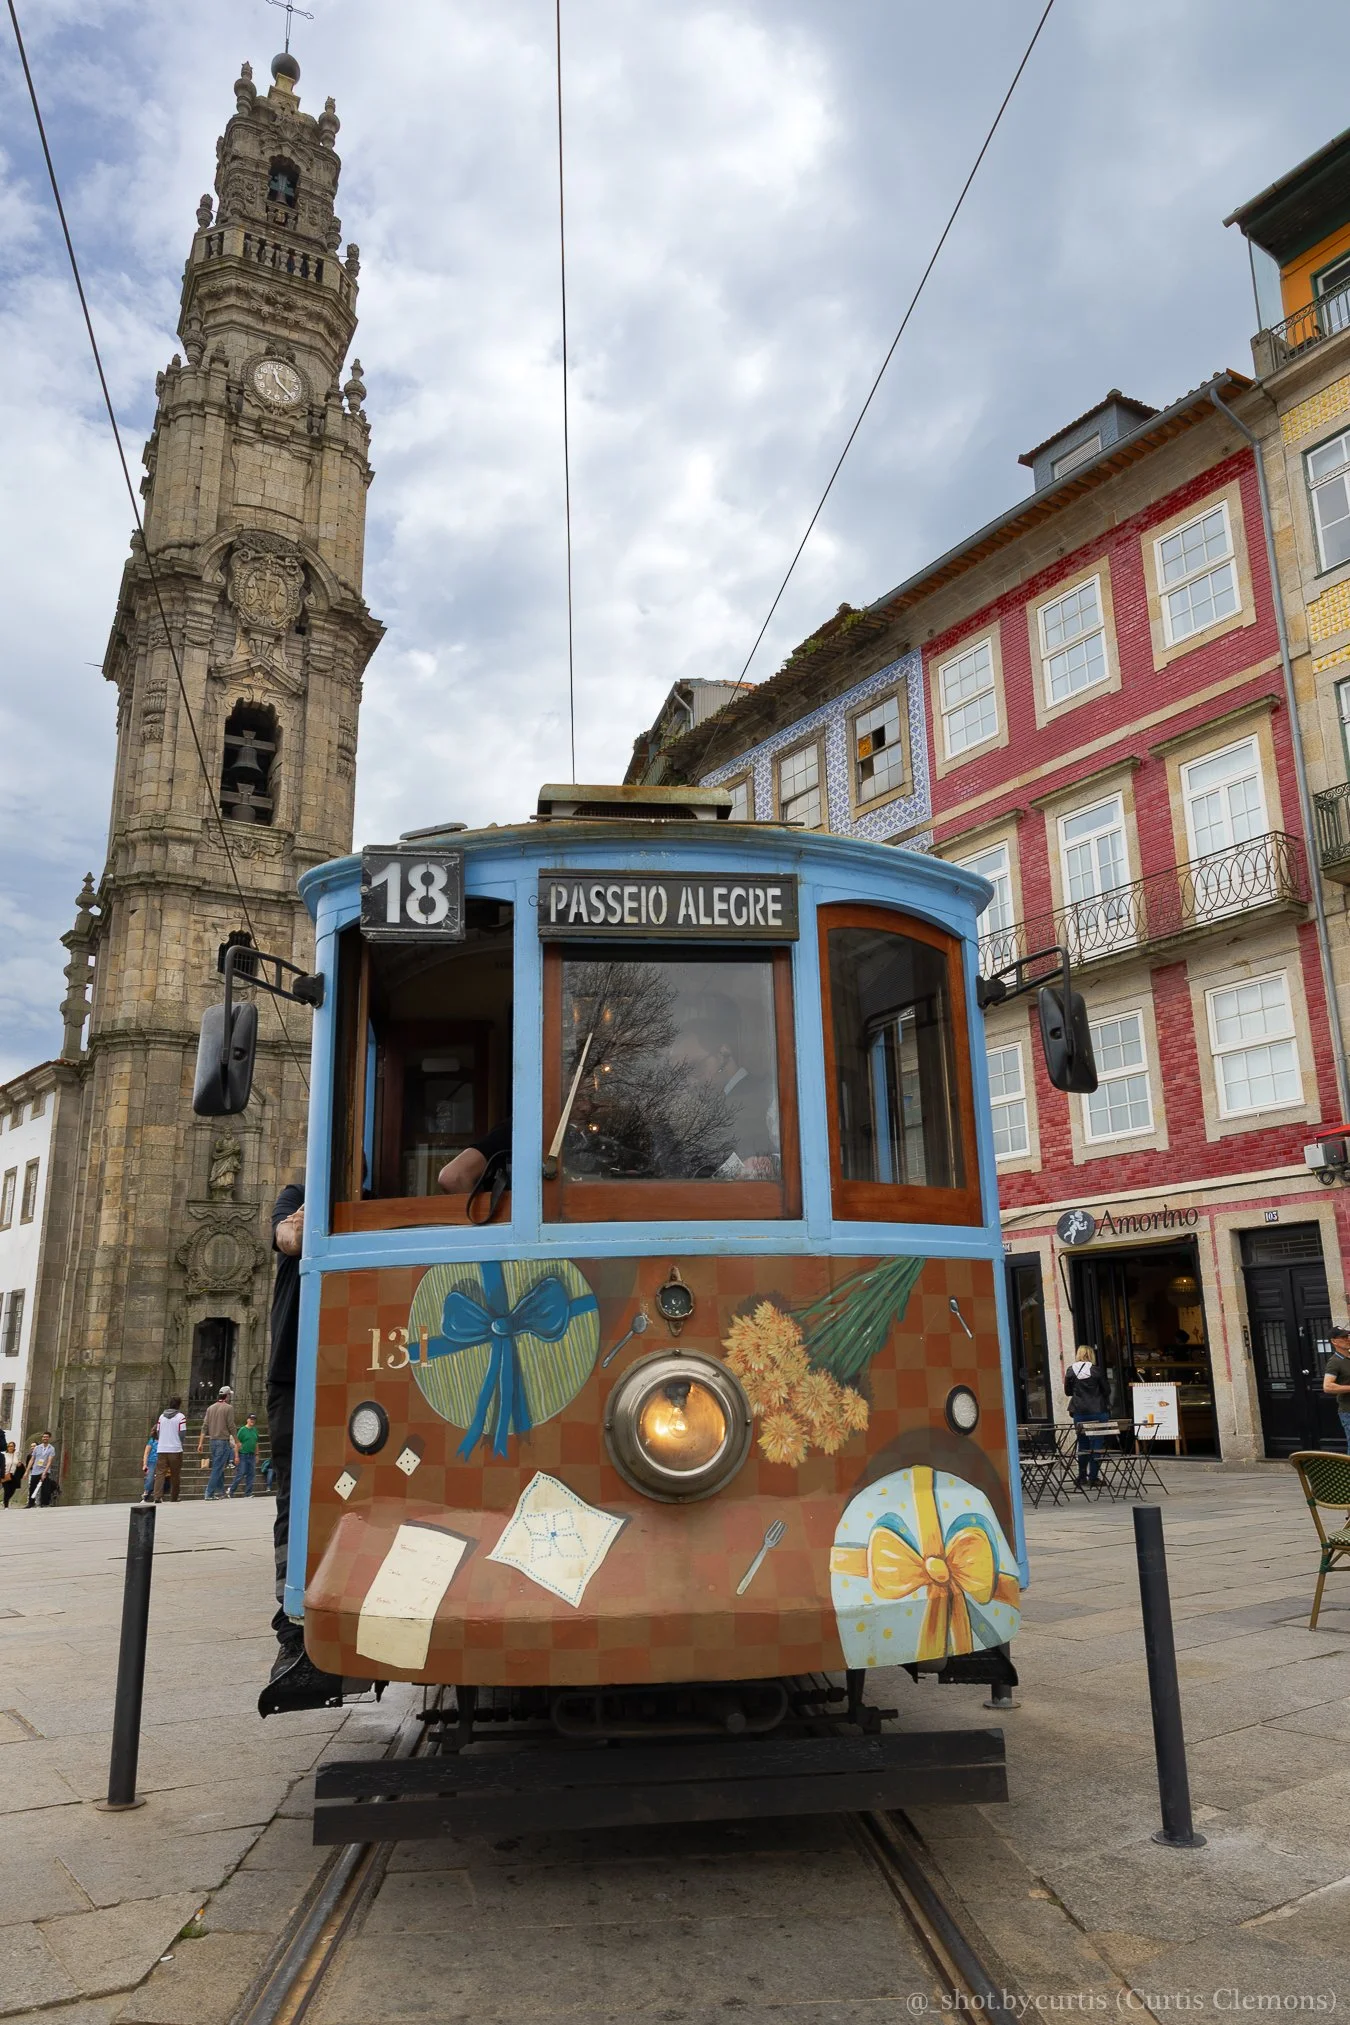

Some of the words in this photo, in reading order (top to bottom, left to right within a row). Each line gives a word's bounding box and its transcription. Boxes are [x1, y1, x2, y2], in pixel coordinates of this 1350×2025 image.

[370, 861, 450, 925] 18
[550, 881, 669, 924] PASSEIO
[676, 886, 783, 926] ALEGRE
[1097, 1203, 1199, 1237] Amorino
[367, 1325, 432, 1371] 131
